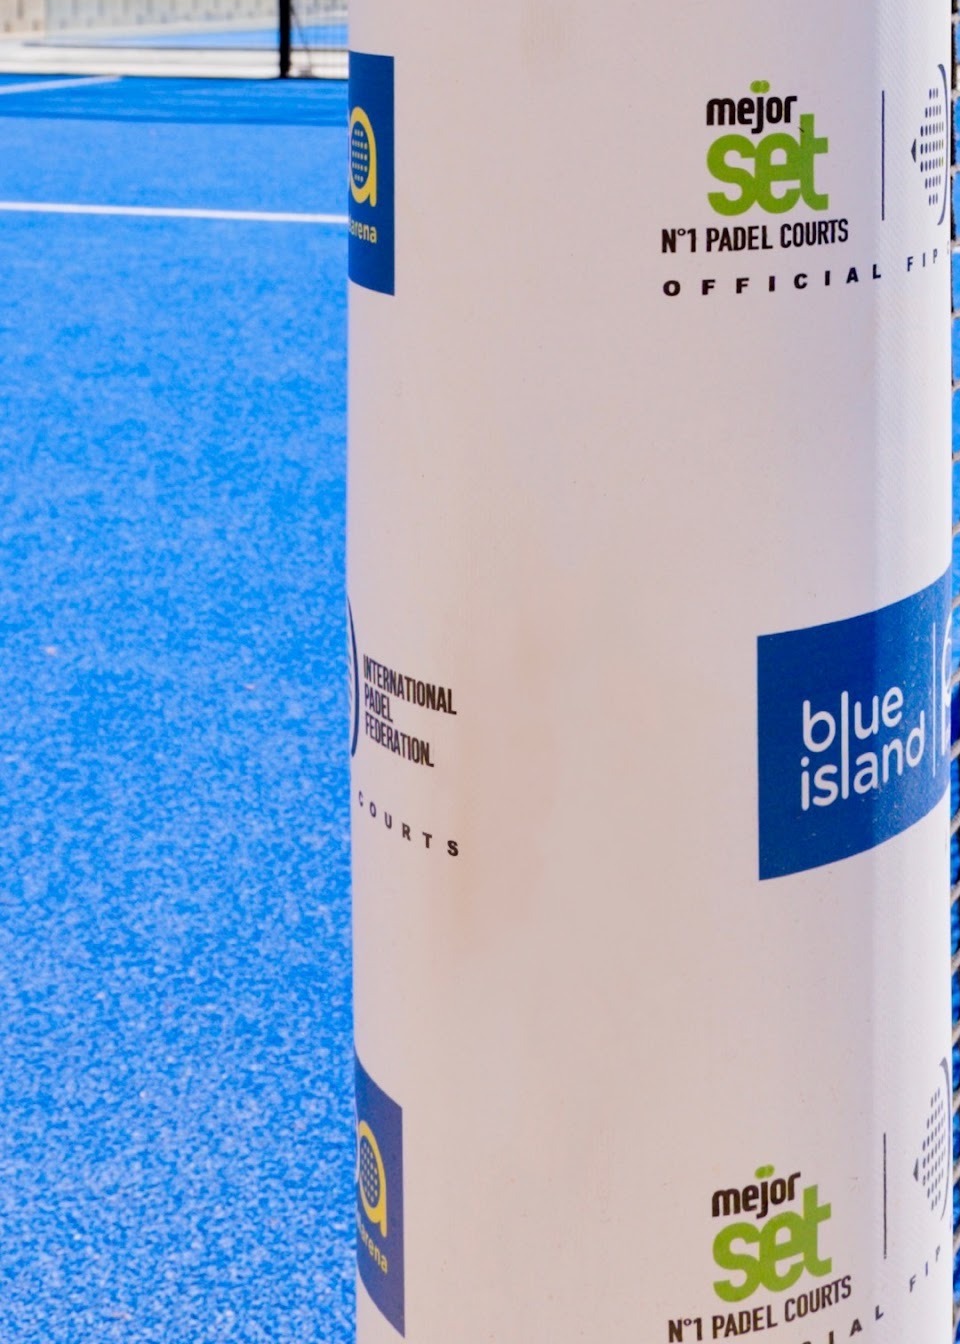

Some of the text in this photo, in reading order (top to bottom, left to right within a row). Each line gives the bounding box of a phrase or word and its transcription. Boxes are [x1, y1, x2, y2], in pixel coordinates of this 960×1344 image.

[705, 79, 798, 135] mejor
[705, 112, 830, 217] set
[349, 216, 378, 244] arena
[705, 225, 773, 253] PADEL
[779, 218, 849, 249] COURTS
[662, 263, 882, 297] OFFICIAL
[906, 247, 938, 273] FIP
[362, 653, 457, 716] INTERNATIONAL
[364, 681, 394, 724] PADEL
[802, 685, 904, 754] blue
[800, 709, 926, 812] island
[357, 789, 460, 857] COURTS
[711, 1163, 802, 1220] mejor
[711, 1183, 832, 1304] set
[711, 1303, 778, 1340] PADEL
[784, 1274, 852, 1324] COURTS
